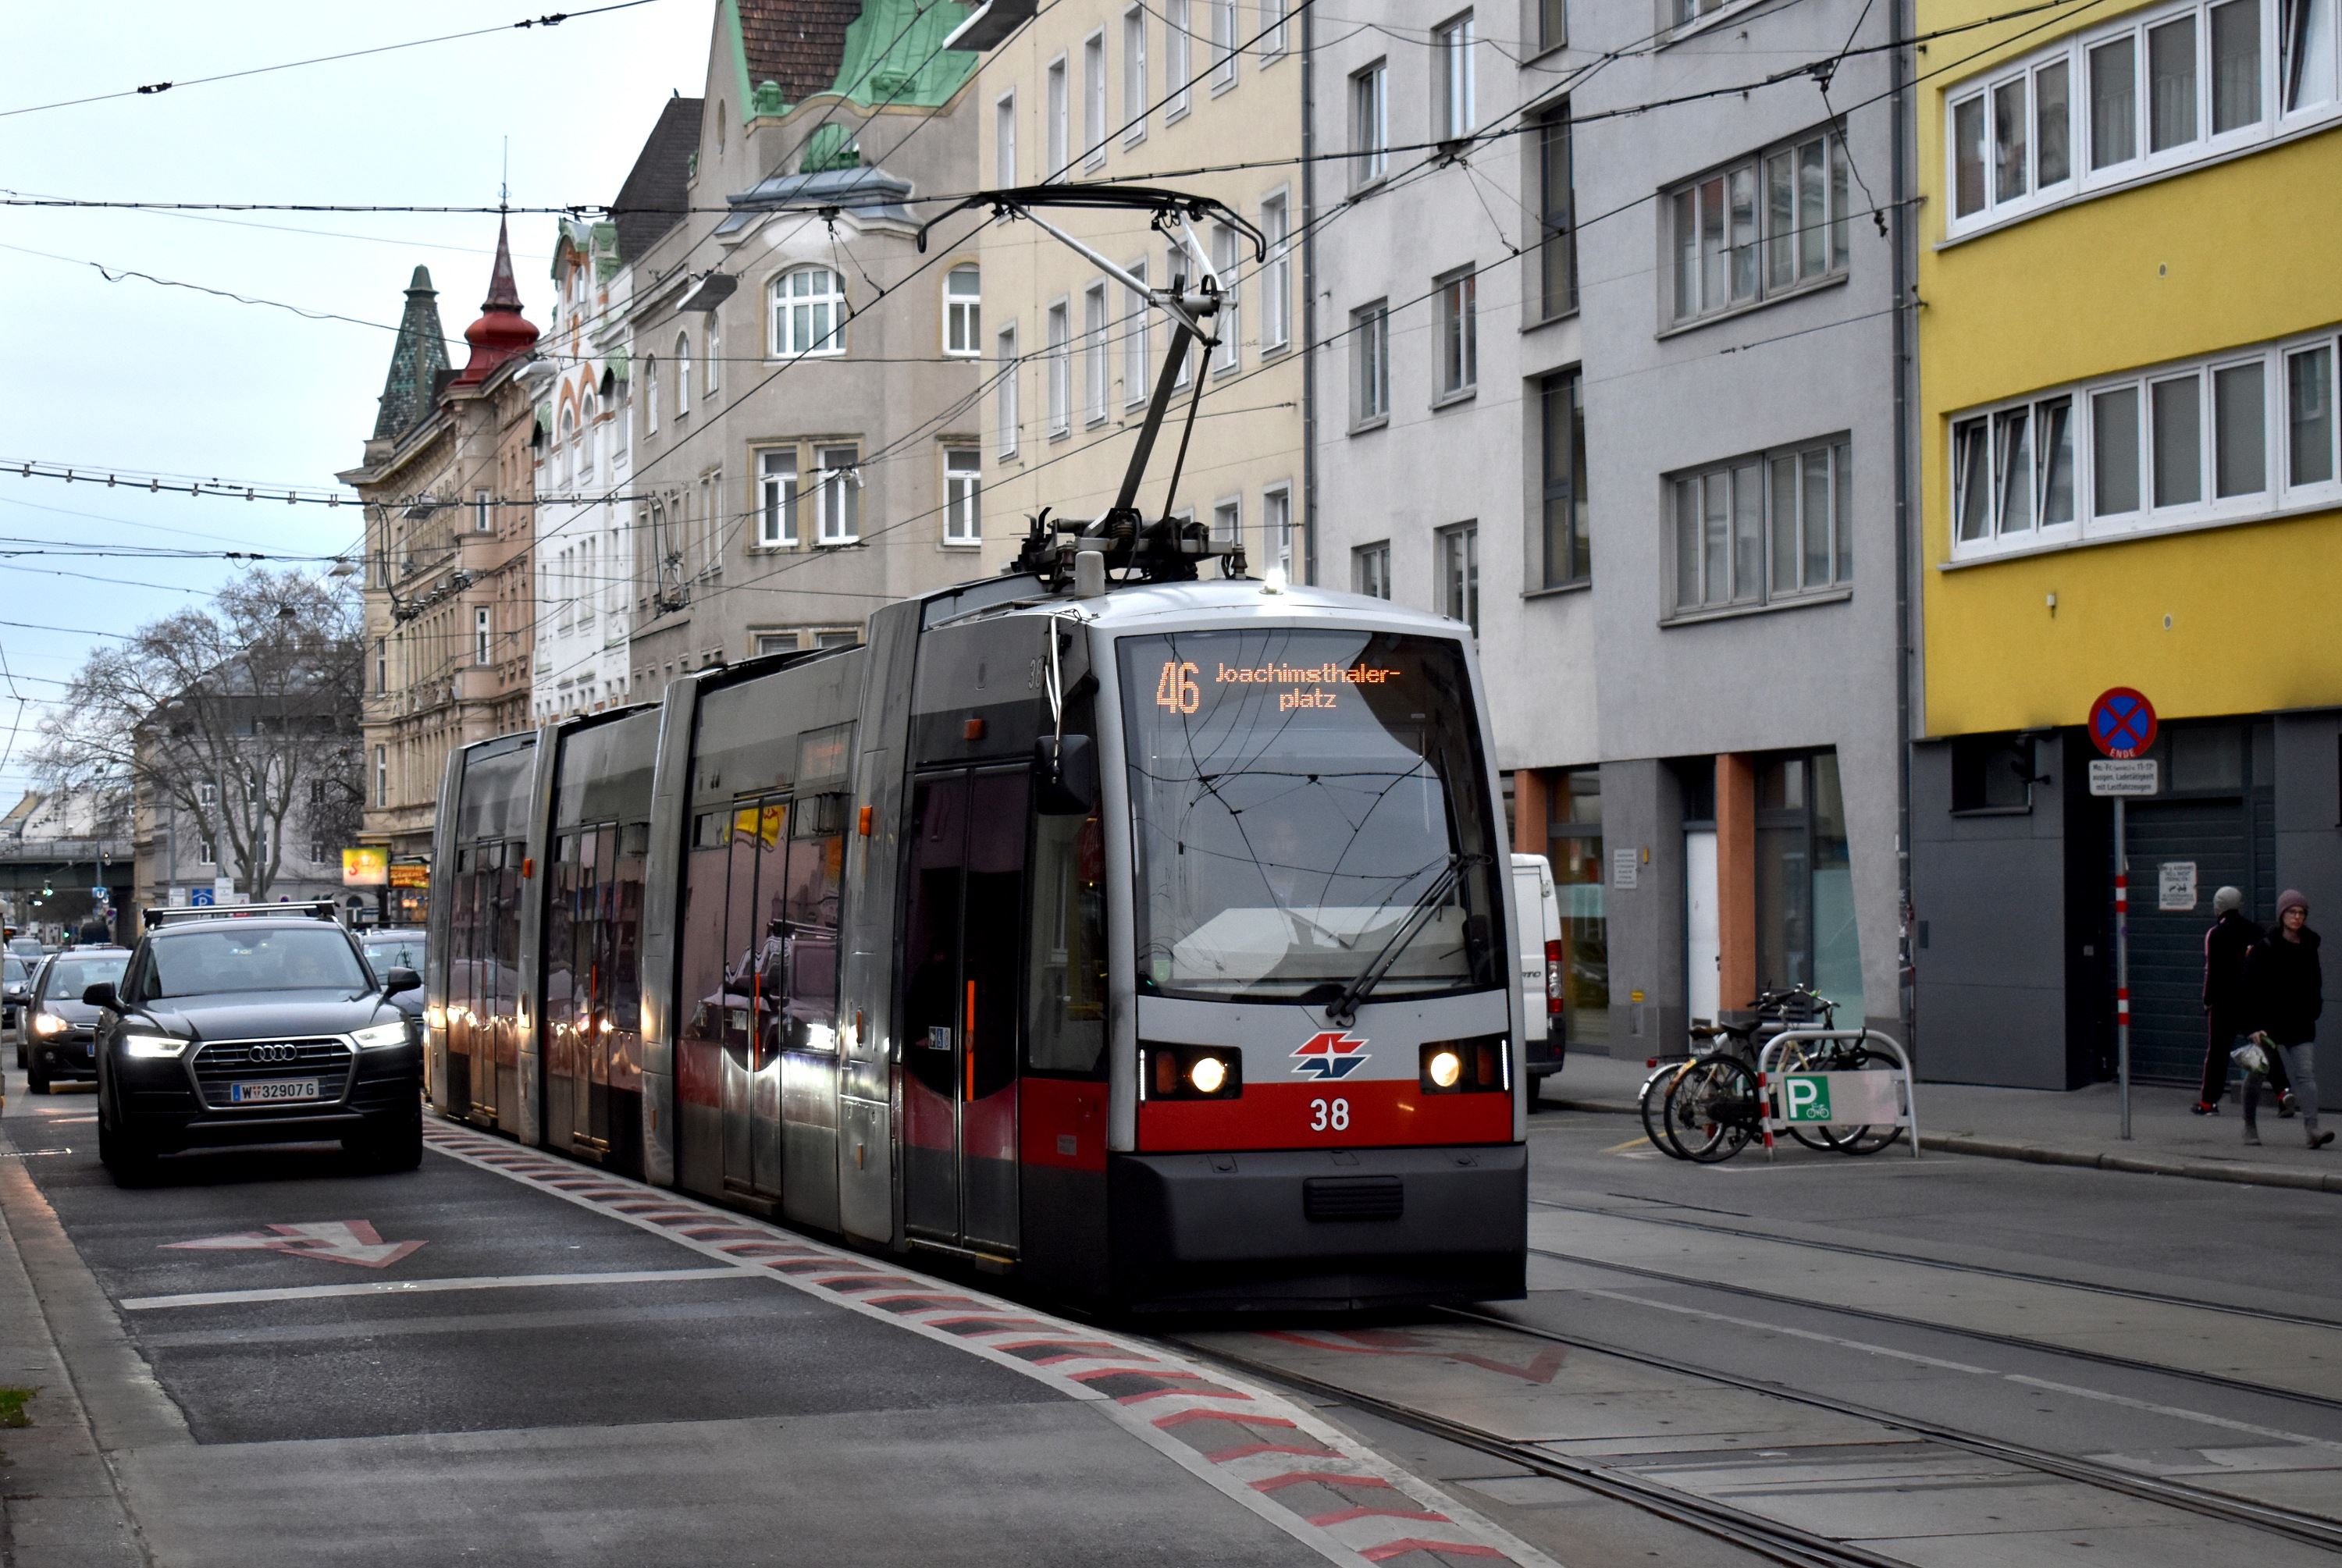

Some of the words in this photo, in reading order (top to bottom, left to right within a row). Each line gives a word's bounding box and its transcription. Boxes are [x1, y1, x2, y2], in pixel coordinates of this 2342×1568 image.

[1028, 657, 1042, 689] 38
[1215, 662, 1402, 684] Joachimsthaler-
[1156, 662, 1200, 713] 46
[1280, 688, 1337, 712] platz
[2109, 747, 2136, 759] ENDE
[96, 891, 105, 899] U
[198, 897, 208, 906] P
[242, 1086, 252, 1099] W
[262, 1083, 304, 1098] 32907
[307, 1083, 314, 1096] G
[1786, 1079, 1817, 1118] P
[1310, 1097, 1350, 1132] 38
